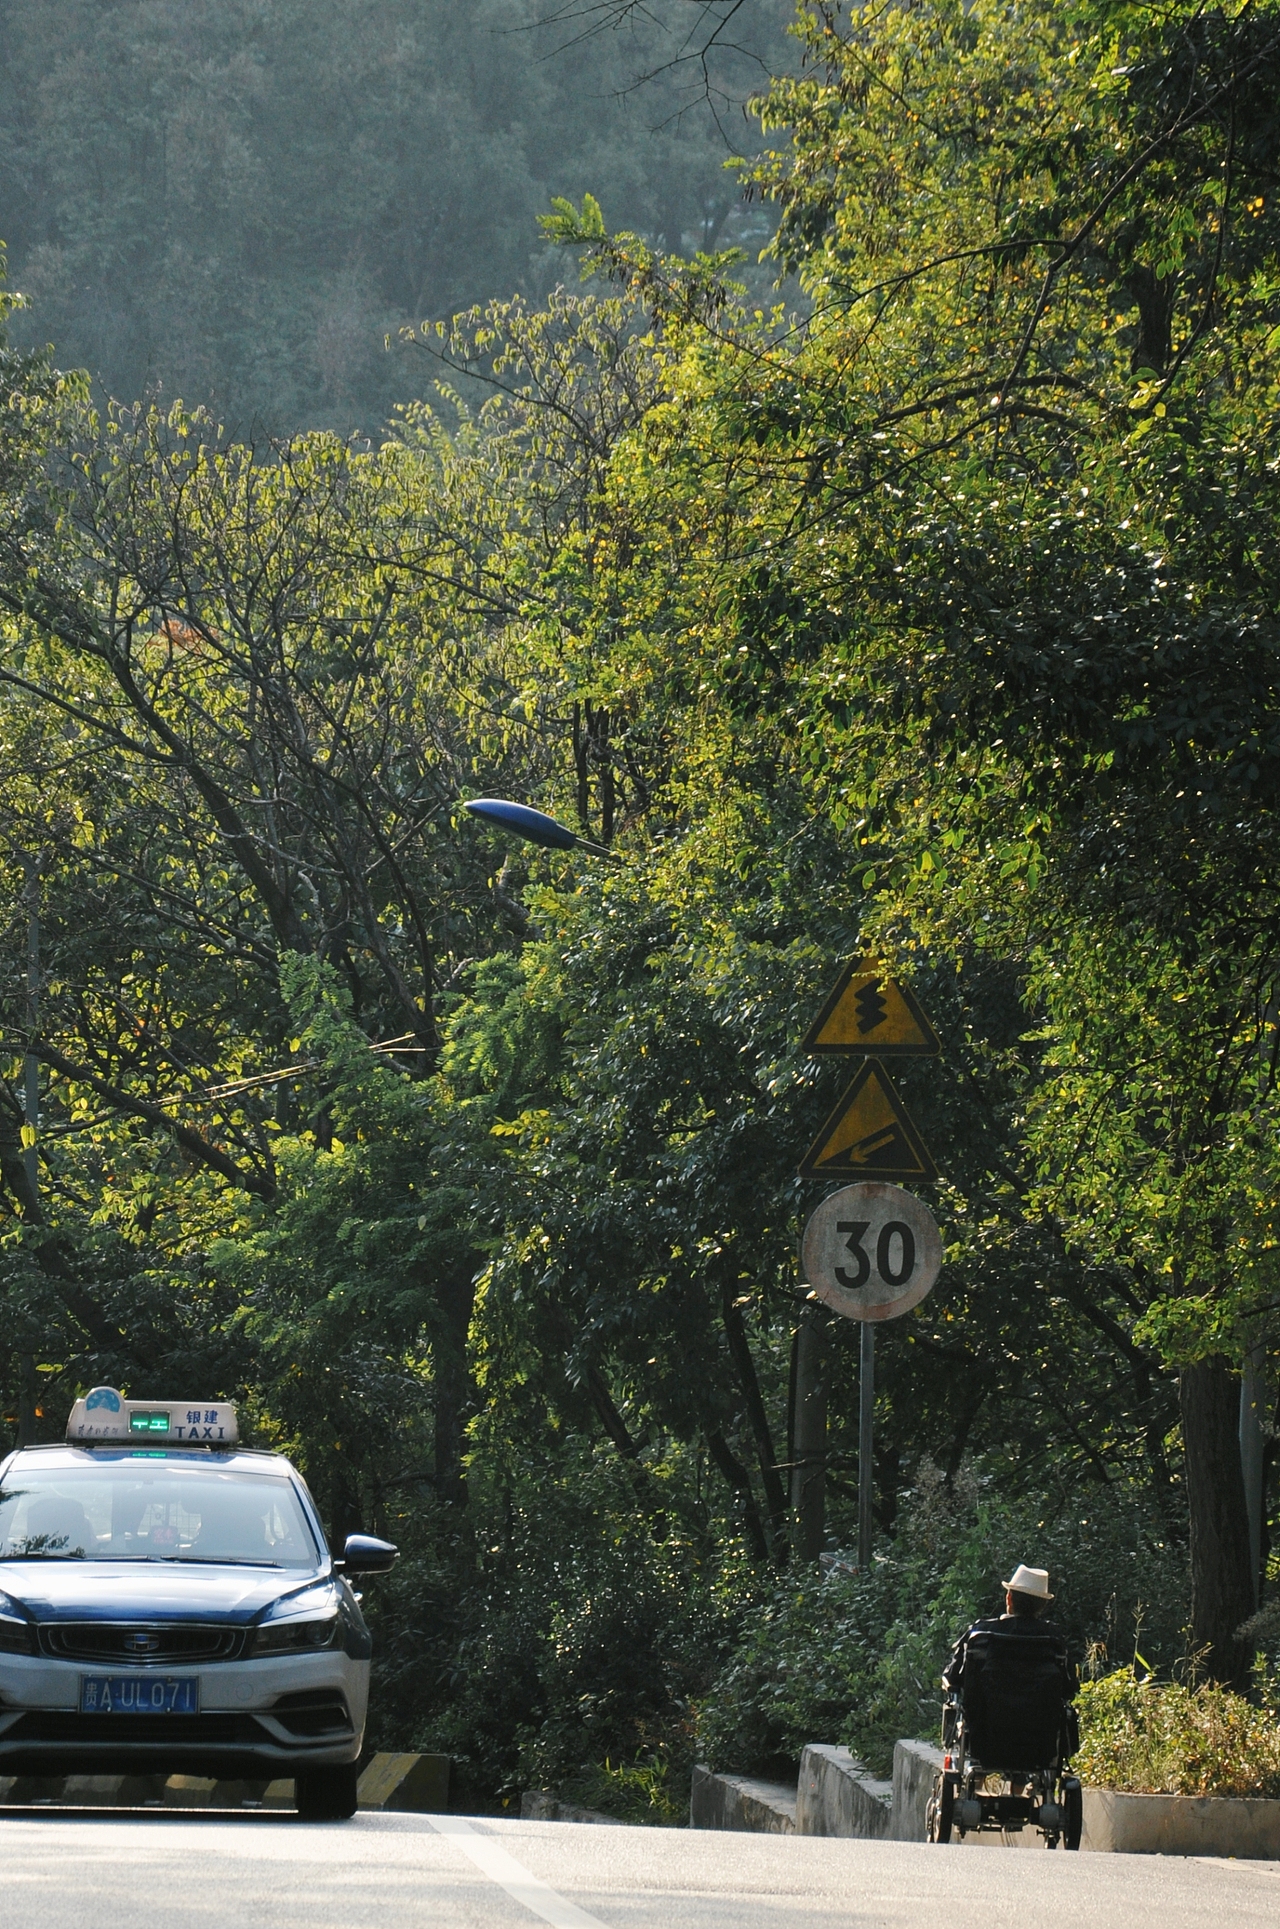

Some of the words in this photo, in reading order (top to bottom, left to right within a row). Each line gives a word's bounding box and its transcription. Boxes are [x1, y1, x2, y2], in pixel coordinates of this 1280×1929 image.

[834, 1221, 915, 1289] 30
[186, 1410, 219, 1425] 银建
[175, 1426, 225, 1439] TAXI
